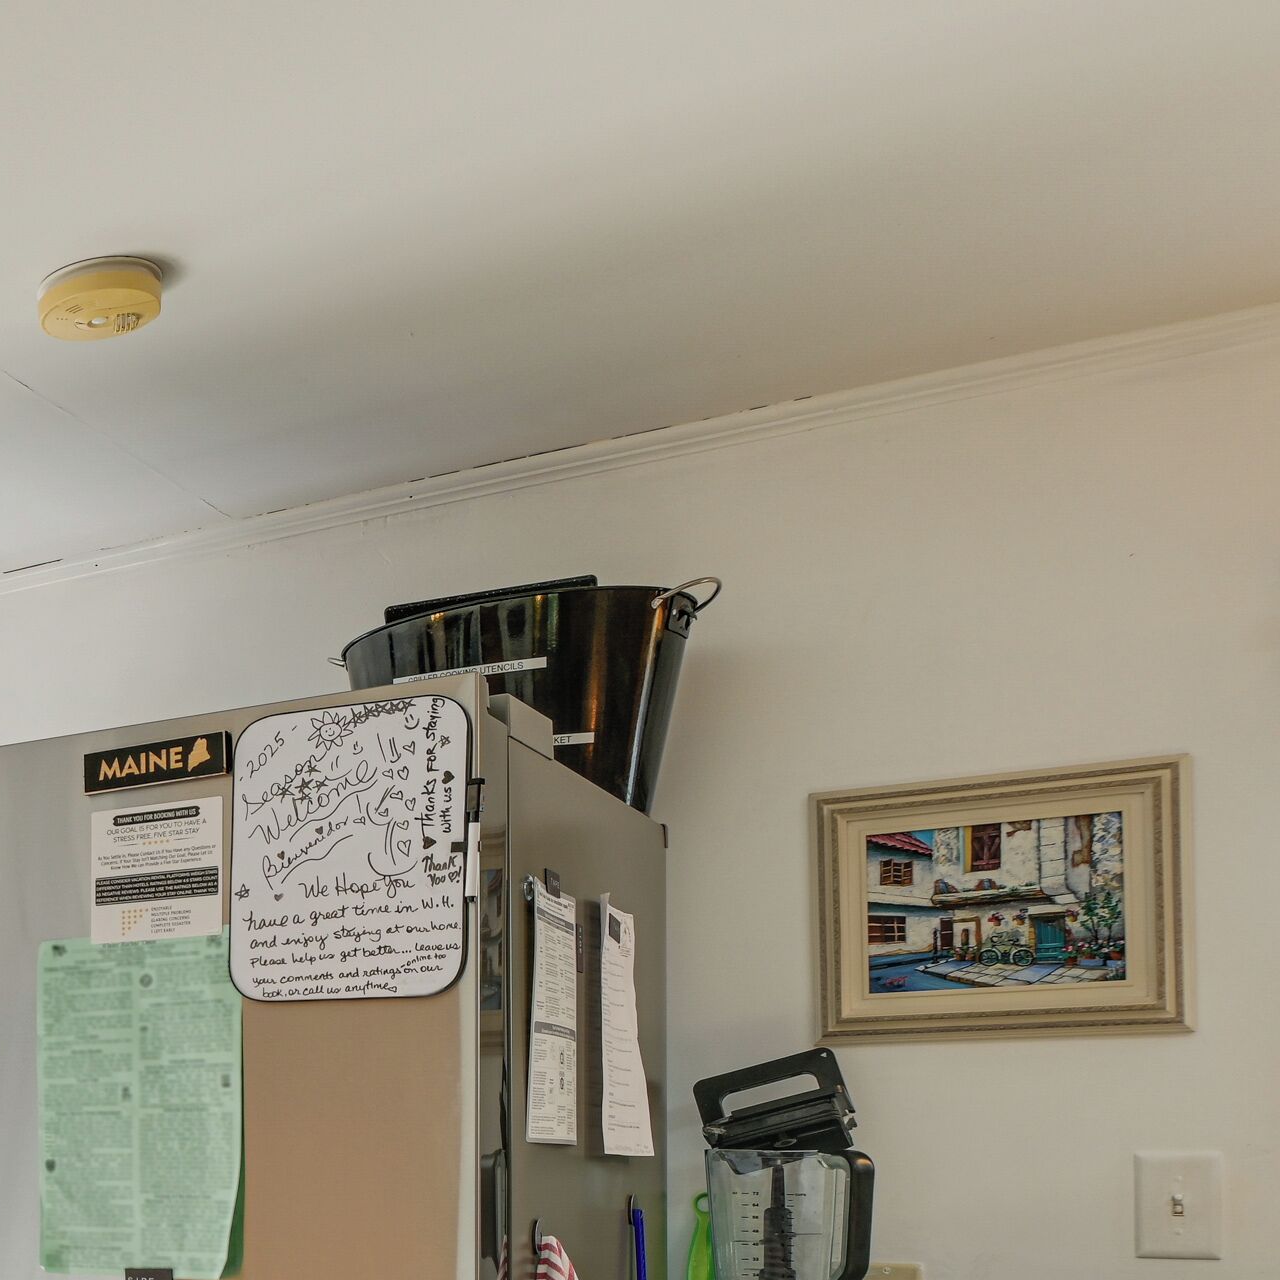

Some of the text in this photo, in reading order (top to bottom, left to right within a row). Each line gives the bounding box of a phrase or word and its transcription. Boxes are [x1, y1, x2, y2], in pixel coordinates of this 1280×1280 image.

[479, 661, 525, 675] UTENCILS
[98, 746, 184, 782] MAINE
[246, 731, 286, 778] 2025
[248, 759, 378, 843] Welcome
[415, 779, 436, 839] Thanks
[439, 786, 453, 834] with us
[144, 813, 154, 821] FOR
[154, 811, 175, 820] BOOKING
[176, 809, 189, 817] WITH
[189, 808, 197, 816] US
[106, 828, 119, 836] OUR
[120, 826, 137, 834] GOAL
[139, 824, 145, 832] IS
[146, 823, 159, 831] FOR
[159, 821, 172, 830] YOU
[174, 820, 182, 828] TO
[113, 835, 135, 843] STRESS
[153, 831, 167, 839] FIVE
[168, 829, 183, 837] STAR
[184, 827, 200, 835] STAY
[422, 853, 458, 873] Thank
[298, 873, 329, 899] We
[335, 871, 378, 899] Hope
[242, 895, 455, 931] have a great time in W.H.
[250, 934, 278, 949] and
[281, 929, 329, 950] enjoy
[333, 925, 383, 942] staying
[386, 923, 406, 934] at
[406, 923, 431, 934] our
[249, 954, 288, 968] Please
[291, 953, 321, 967] help
[319, 953, 337, 963] us
[339, 949, 362, 963] get
[445, 942, 461, 951] us
[434, 952, 447, 961] too
[252, 964, 444, 989] your comments and ratings on our
[302, 983, 325, 996] call
[325, 986, 342, 994] us
[344, 981, 391, 994] anytime
